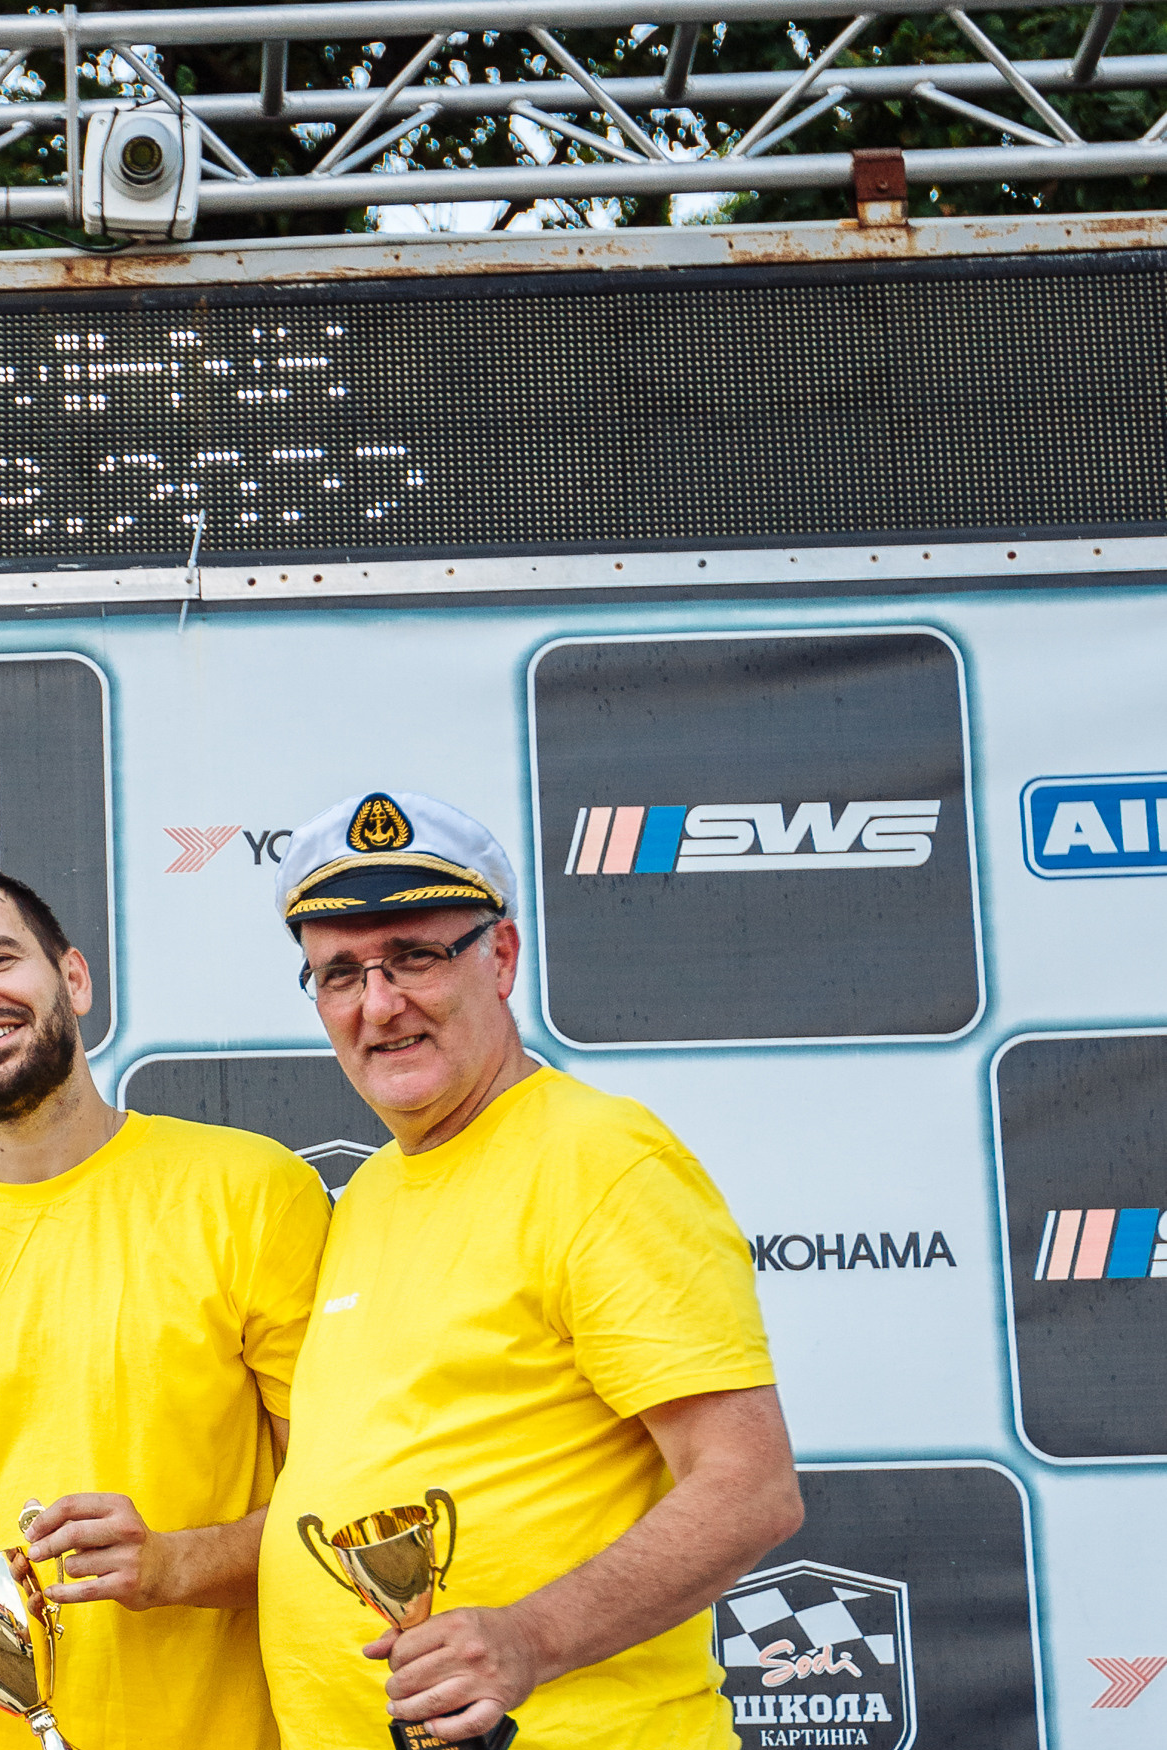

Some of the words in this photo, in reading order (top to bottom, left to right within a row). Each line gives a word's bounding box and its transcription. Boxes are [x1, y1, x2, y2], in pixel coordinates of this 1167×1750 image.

[676, 800, 941, 873] SWS
[748, 1231, 958, 1271] KOHAMA
[758, 1638, 863, 1688] Sodi
[733, 1693, 893, 1725] ШКОЛА
[409, 1739, 420, 1750] 3
[760, 1728, 869, 1747] КАРТИНГА
